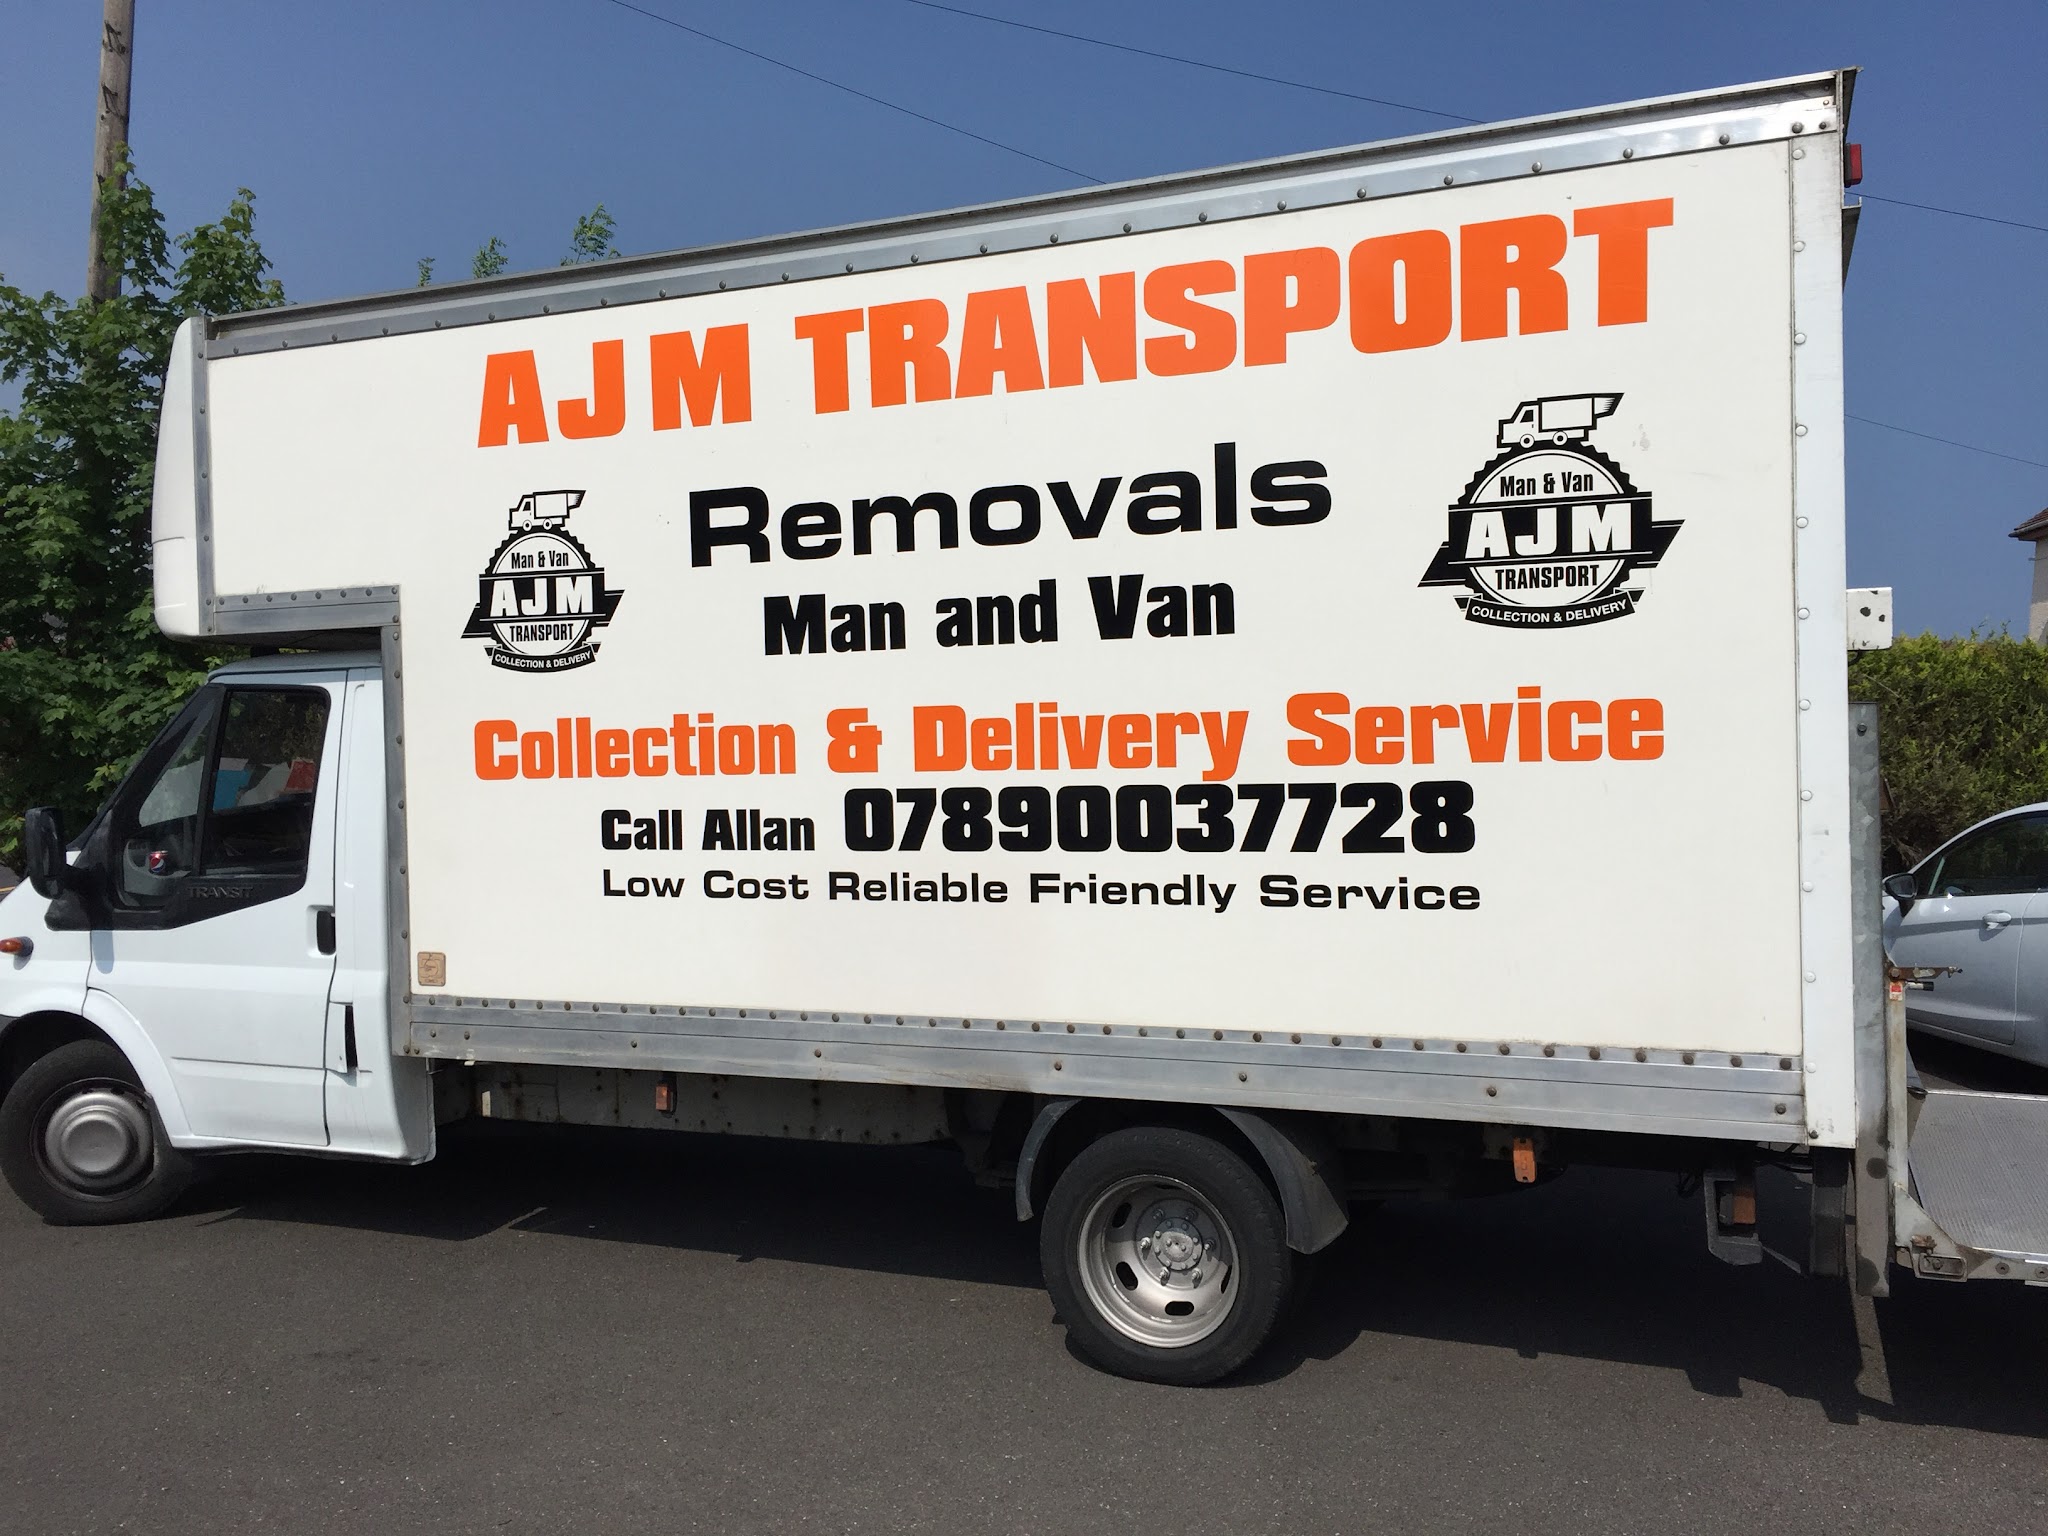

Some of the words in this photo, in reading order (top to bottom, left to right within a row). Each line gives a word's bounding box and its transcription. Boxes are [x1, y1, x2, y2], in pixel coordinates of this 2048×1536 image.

[794, 198, 1674, 415] TRANSPORT
[688, 441, 1332, 568] Removals
[1500, 475, 1536, 496] Man
[1543, 472, 1555, 494] &
[1561, 471, 1594, 493] Van
[1465, 502, 1632, 559] AJM
[511, 552, 534, 569] Man
[538, 551, 546, 568] &
[549, 550, 569, 567] Van
[1495, 564, 1600, 590] TRANSPORT
[490, 575, 594, 617] AJM
[763, 593, 907, 656] Man
[935, 578, 1059, 648] and
[1087, 573, 1236, 641] Van
[1471, 605, 1550, 623] COLLECTION
[1553, 612, 1562, 622] &
[1565, 599, 1627, 621] DELIVERY
[509, 623, 574, 642] TRANSPORT
[495, 654, 545, 668] COLLECTION
[553, 650, 592, 667] DELIVERY
[474, 712, 797, 781] Collection
[826, 707, 883, 774] &
[912, 701, 1249, 783] Delivery
[1286, 685, 1664, 767] Service
[601, 809, 683, 851] Call
[701, 808, 816, 851] Allan
[844, 780, 1476, 854] 07890037728
[187, 886, 253, 899] TRANSIT
[603, 870, 685, 898] Low
[703, 869, 809, 900] Cost
[828, 871, 1008, 903] Reliable
[1029, 872, 1237, 914] Friendly
[1259, 874, 1480, 911] Service
